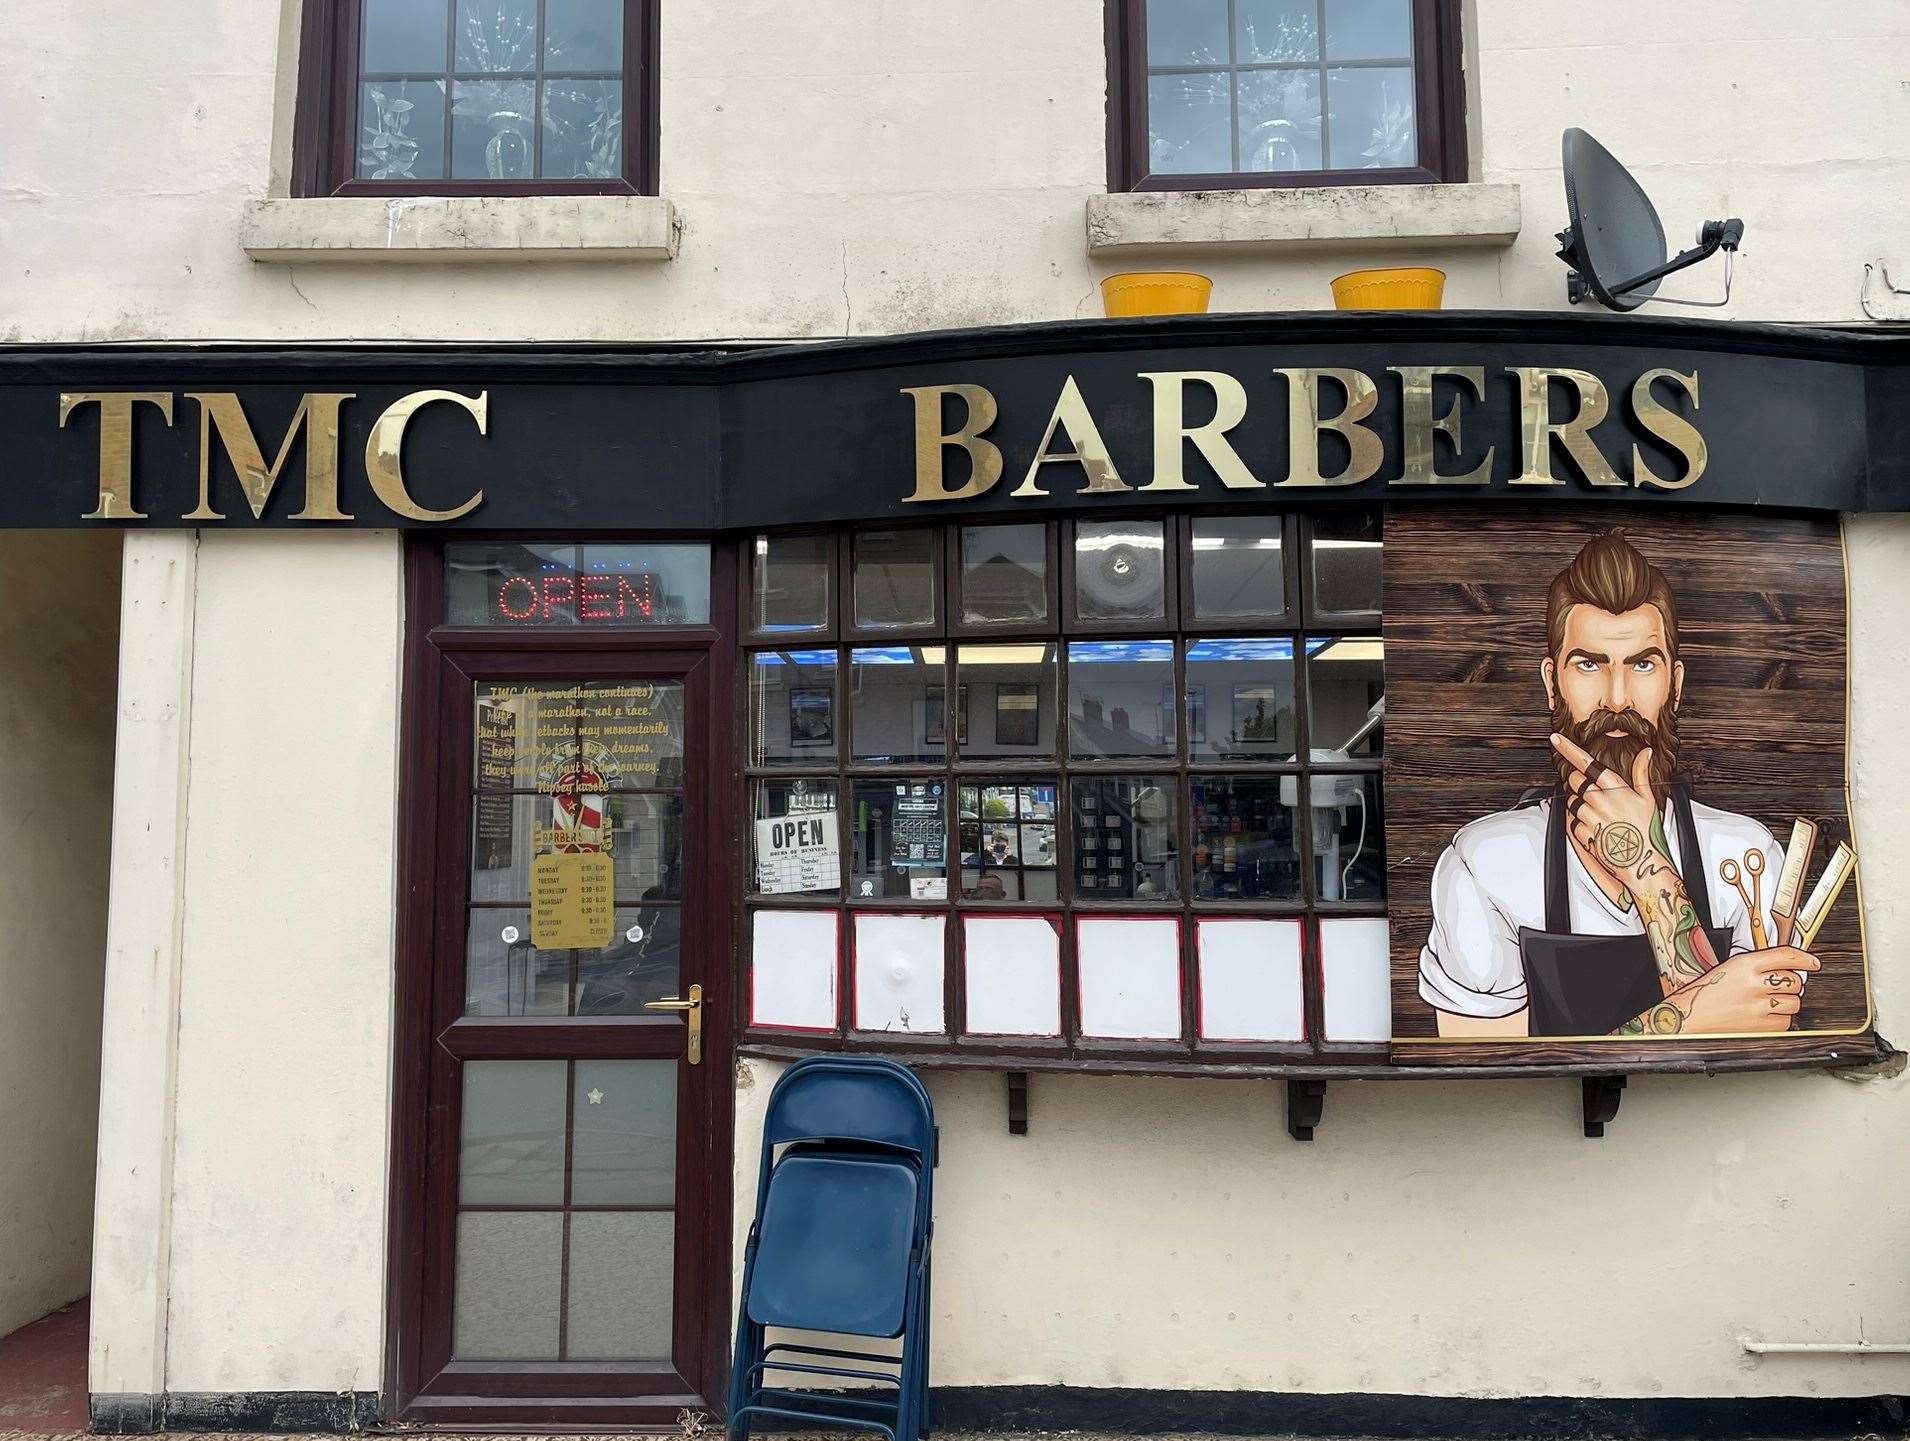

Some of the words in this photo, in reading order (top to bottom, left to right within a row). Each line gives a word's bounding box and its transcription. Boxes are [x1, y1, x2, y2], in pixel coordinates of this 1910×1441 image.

[60, 389, 488, 522] TMC
[899, 365, 1709, 503] BARBERS
[499, 574, 651, 619] OPEN
[595, 705, 613, 716] not
[578, 727, 600, 739] may
[604, 722, 669, 736] momentarily
[771, 819, 824, 849] OPEN
